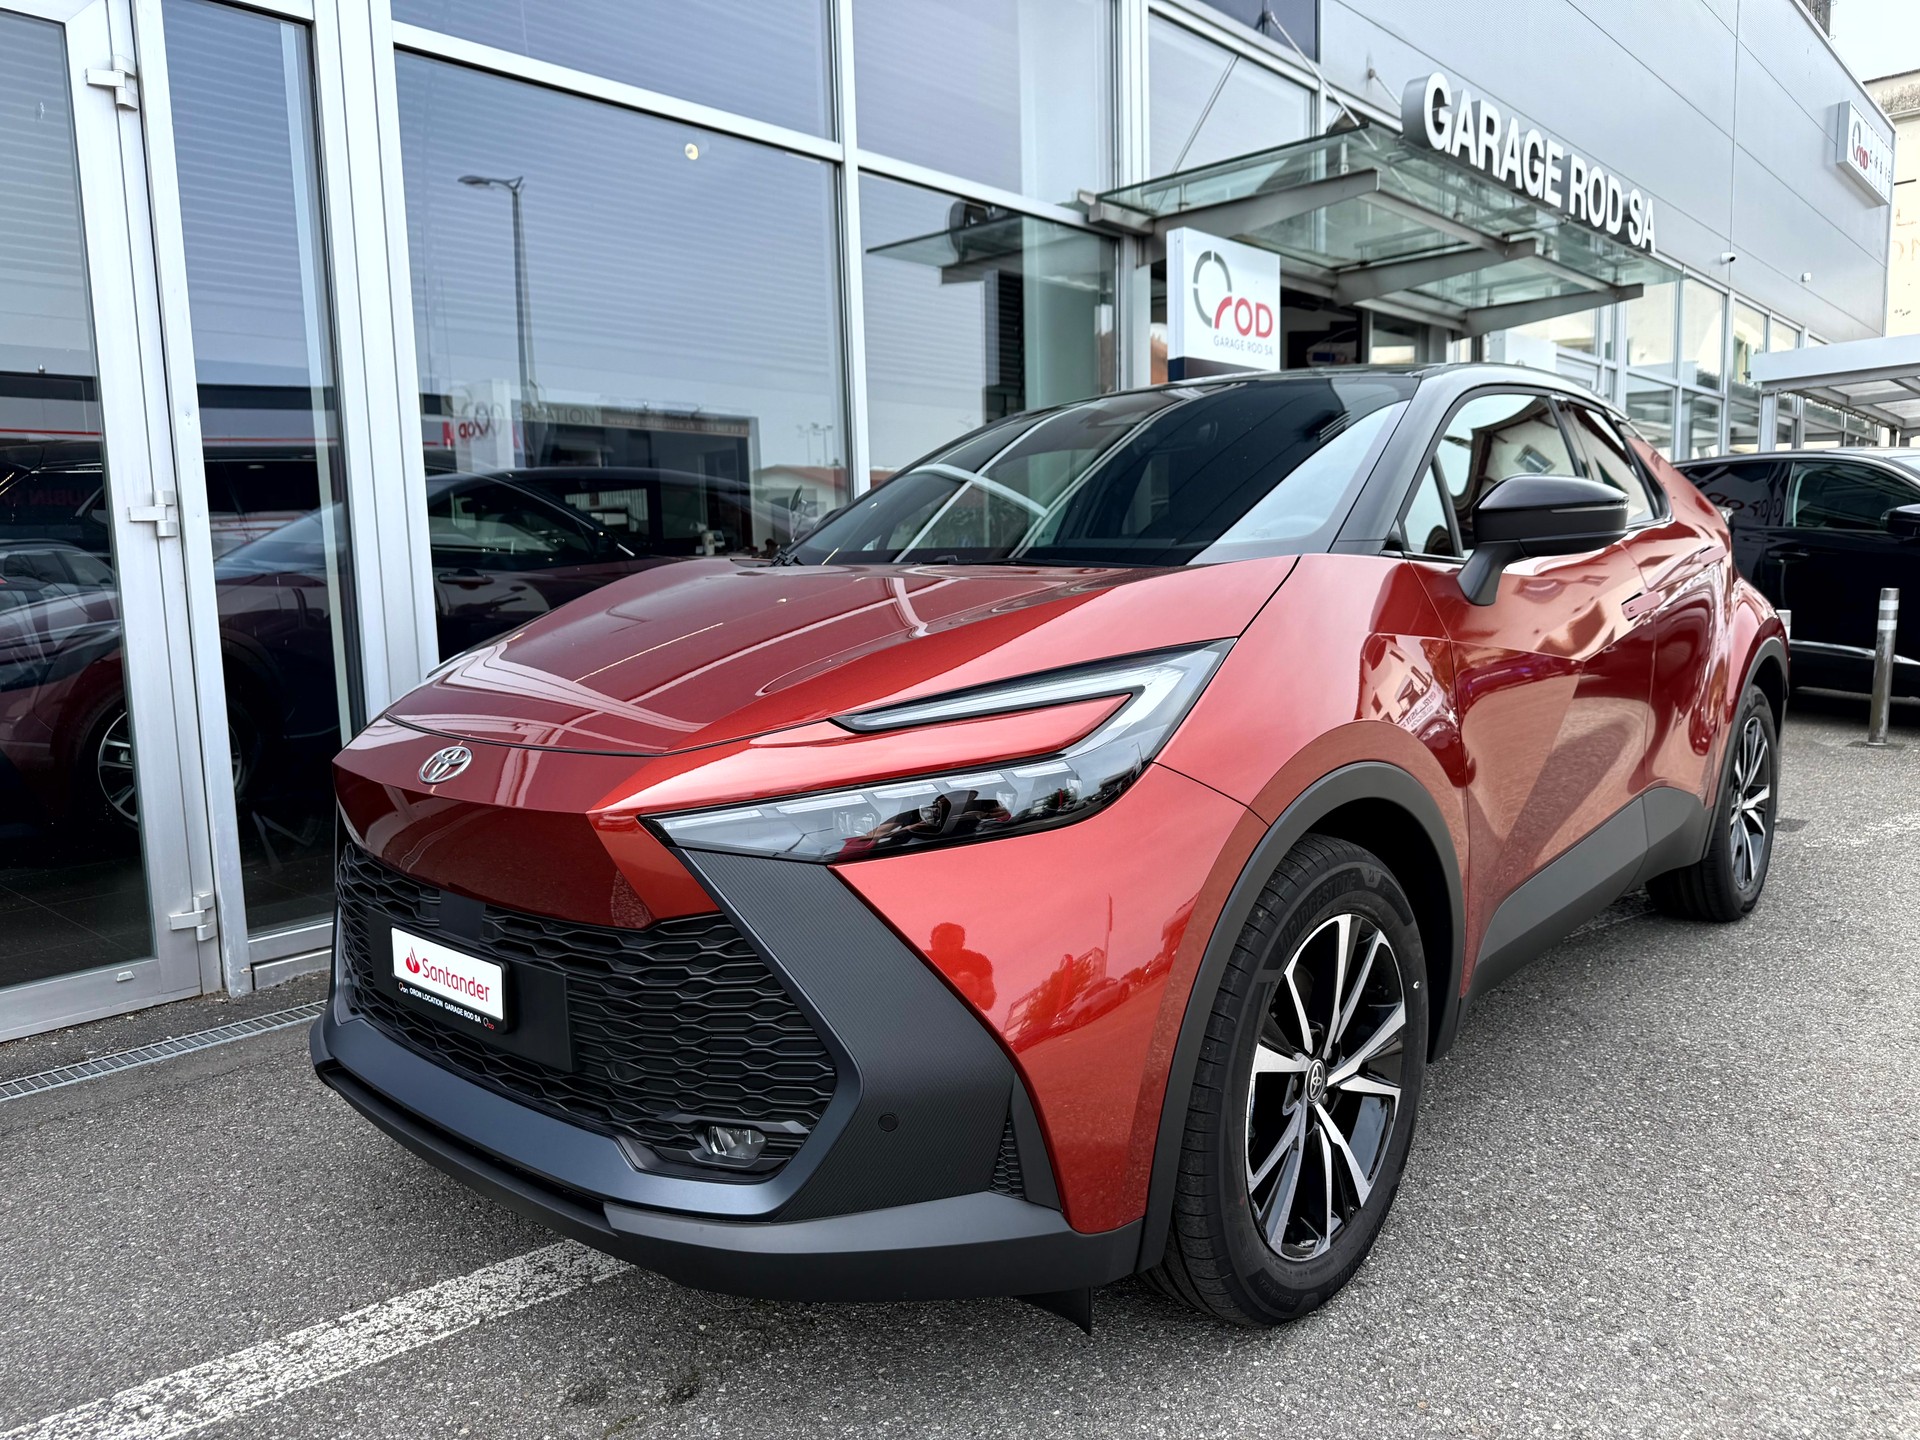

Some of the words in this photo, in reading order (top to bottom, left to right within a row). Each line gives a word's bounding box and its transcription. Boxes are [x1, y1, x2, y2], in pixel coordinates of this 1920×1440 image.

[1424, 72, 1563, 208] GARAGE
[1569, 154, 1623, 236] ROD
[1628, 188, 1656, 254] SA
[1213, 335, 1245, 351] GARAGE
[1247, 341, 1264, 354] ROD
[1265, 345, 1273, 356] SA
[422, 958, 490, 1002] Santander
[409, 987, 422, 998] ORON
[422, 993, 444, 1008] LOCATION
[444, 1002, 464, 1016] GARAGE
[463, 1010, 474, 1020] ROD
[474, 1014, 482, 1023] SA
